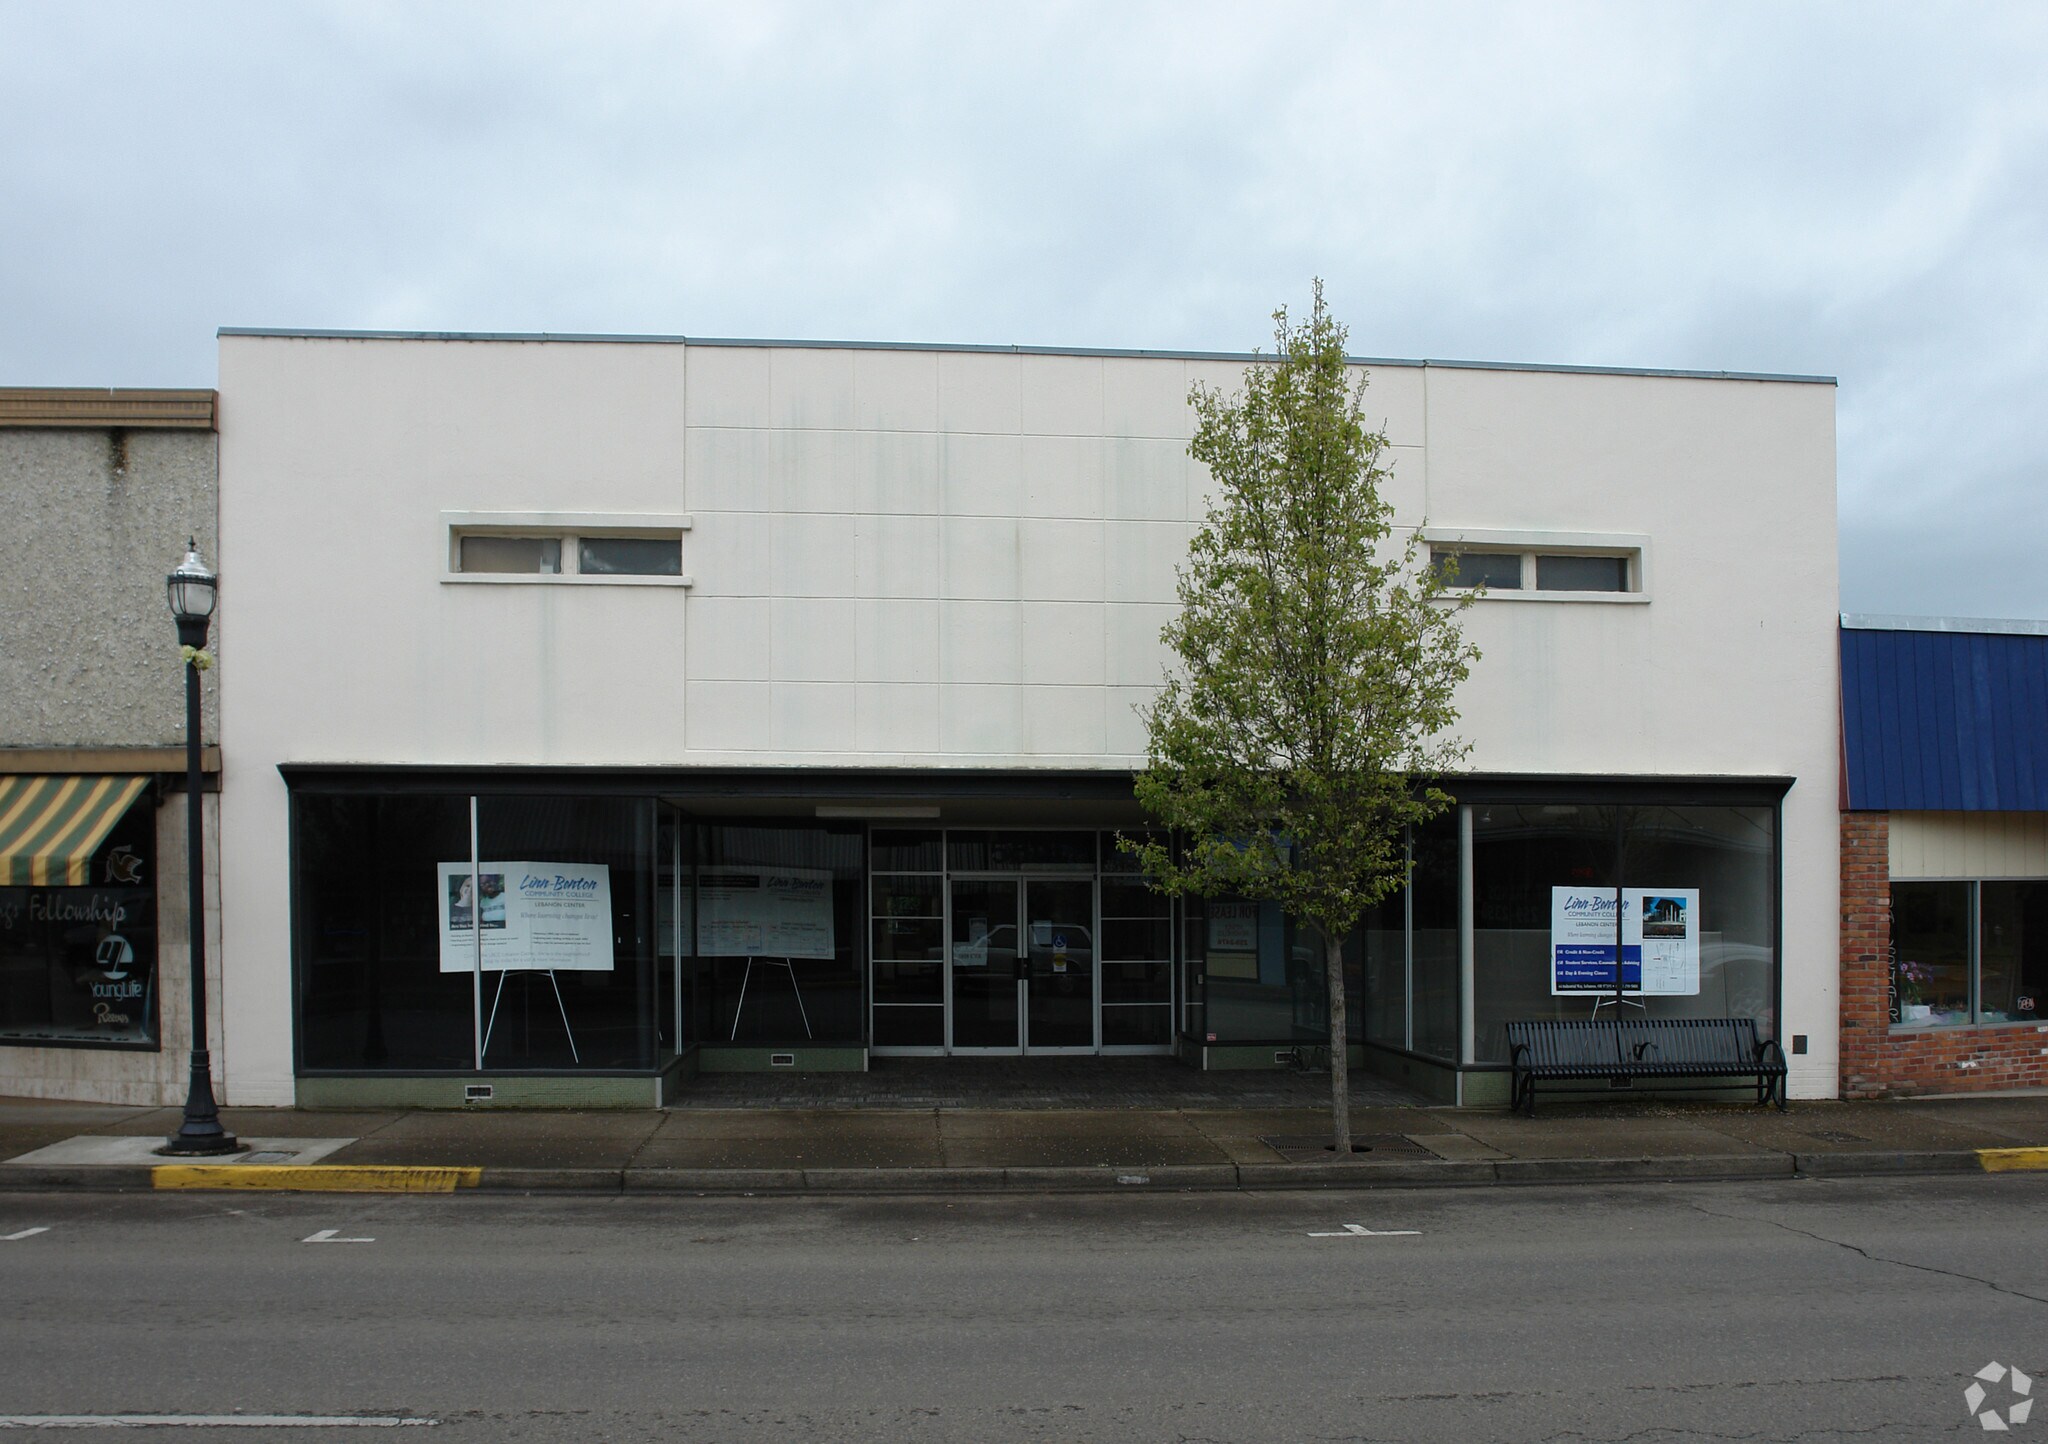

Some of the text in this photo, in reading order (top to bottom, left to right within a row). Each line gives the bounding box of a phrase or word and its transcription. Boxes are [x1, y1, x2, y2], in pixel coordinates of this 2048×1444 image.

[520, 874, 598, 891] Linn-Benton
[1564, 896, 1630, 912] Linn-Bentn
[29, 894, 127, 932] Fellowship
